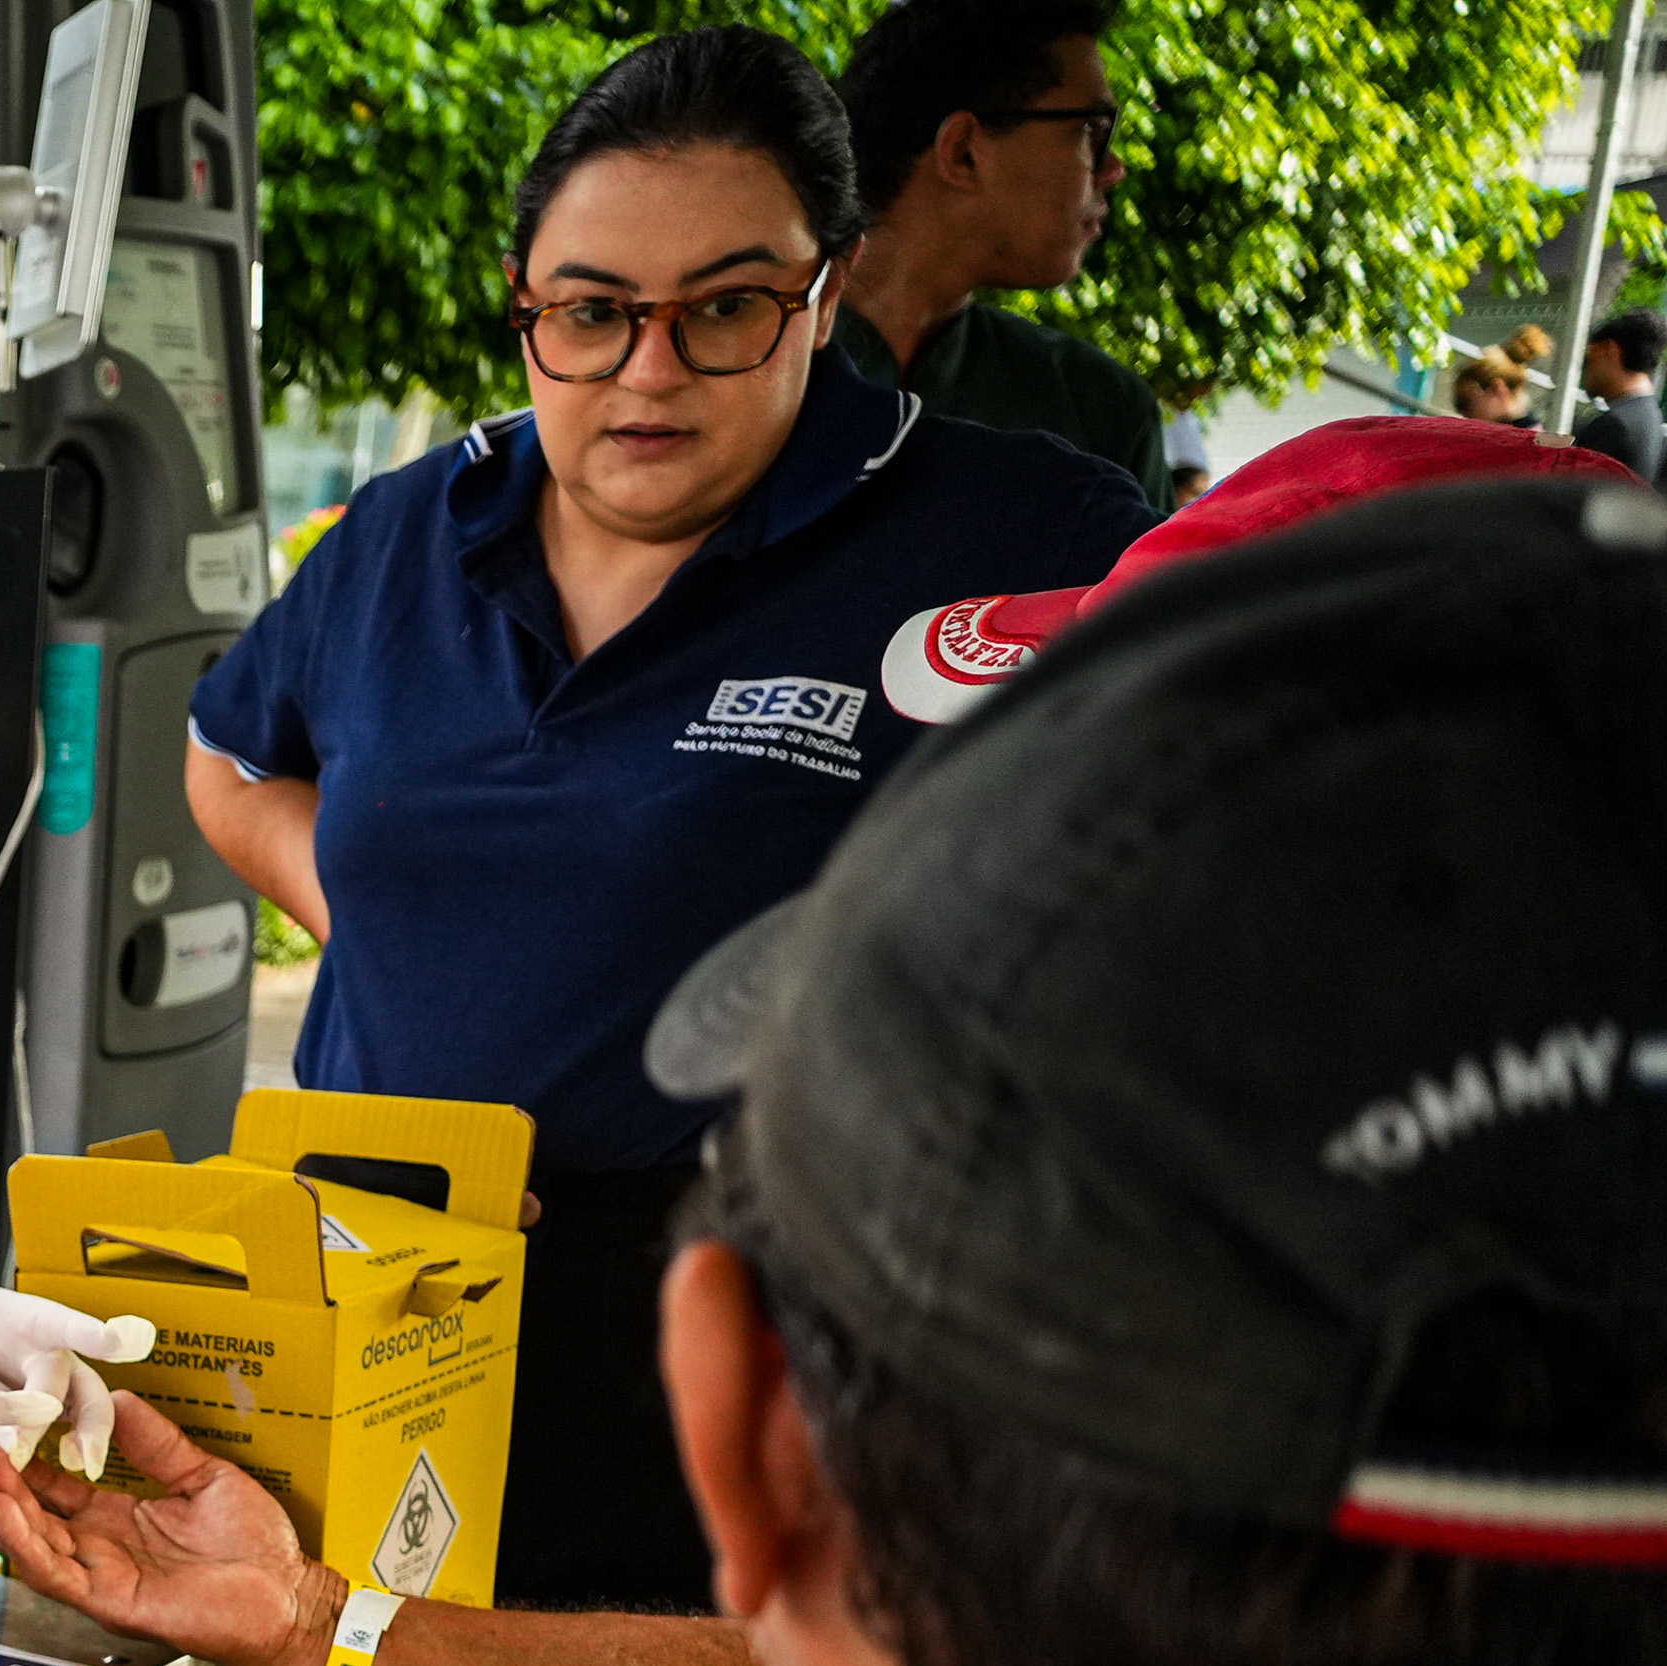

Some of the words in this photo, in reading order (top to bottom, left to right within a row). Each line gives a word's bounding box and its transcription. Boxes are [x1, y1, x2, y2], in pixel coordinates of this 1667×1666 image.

[726, 684, 851, 726] SESI
[175, 1330, 276, 1358] MATERIAIS
[401, 1407, 446, 1443] PERIGO
